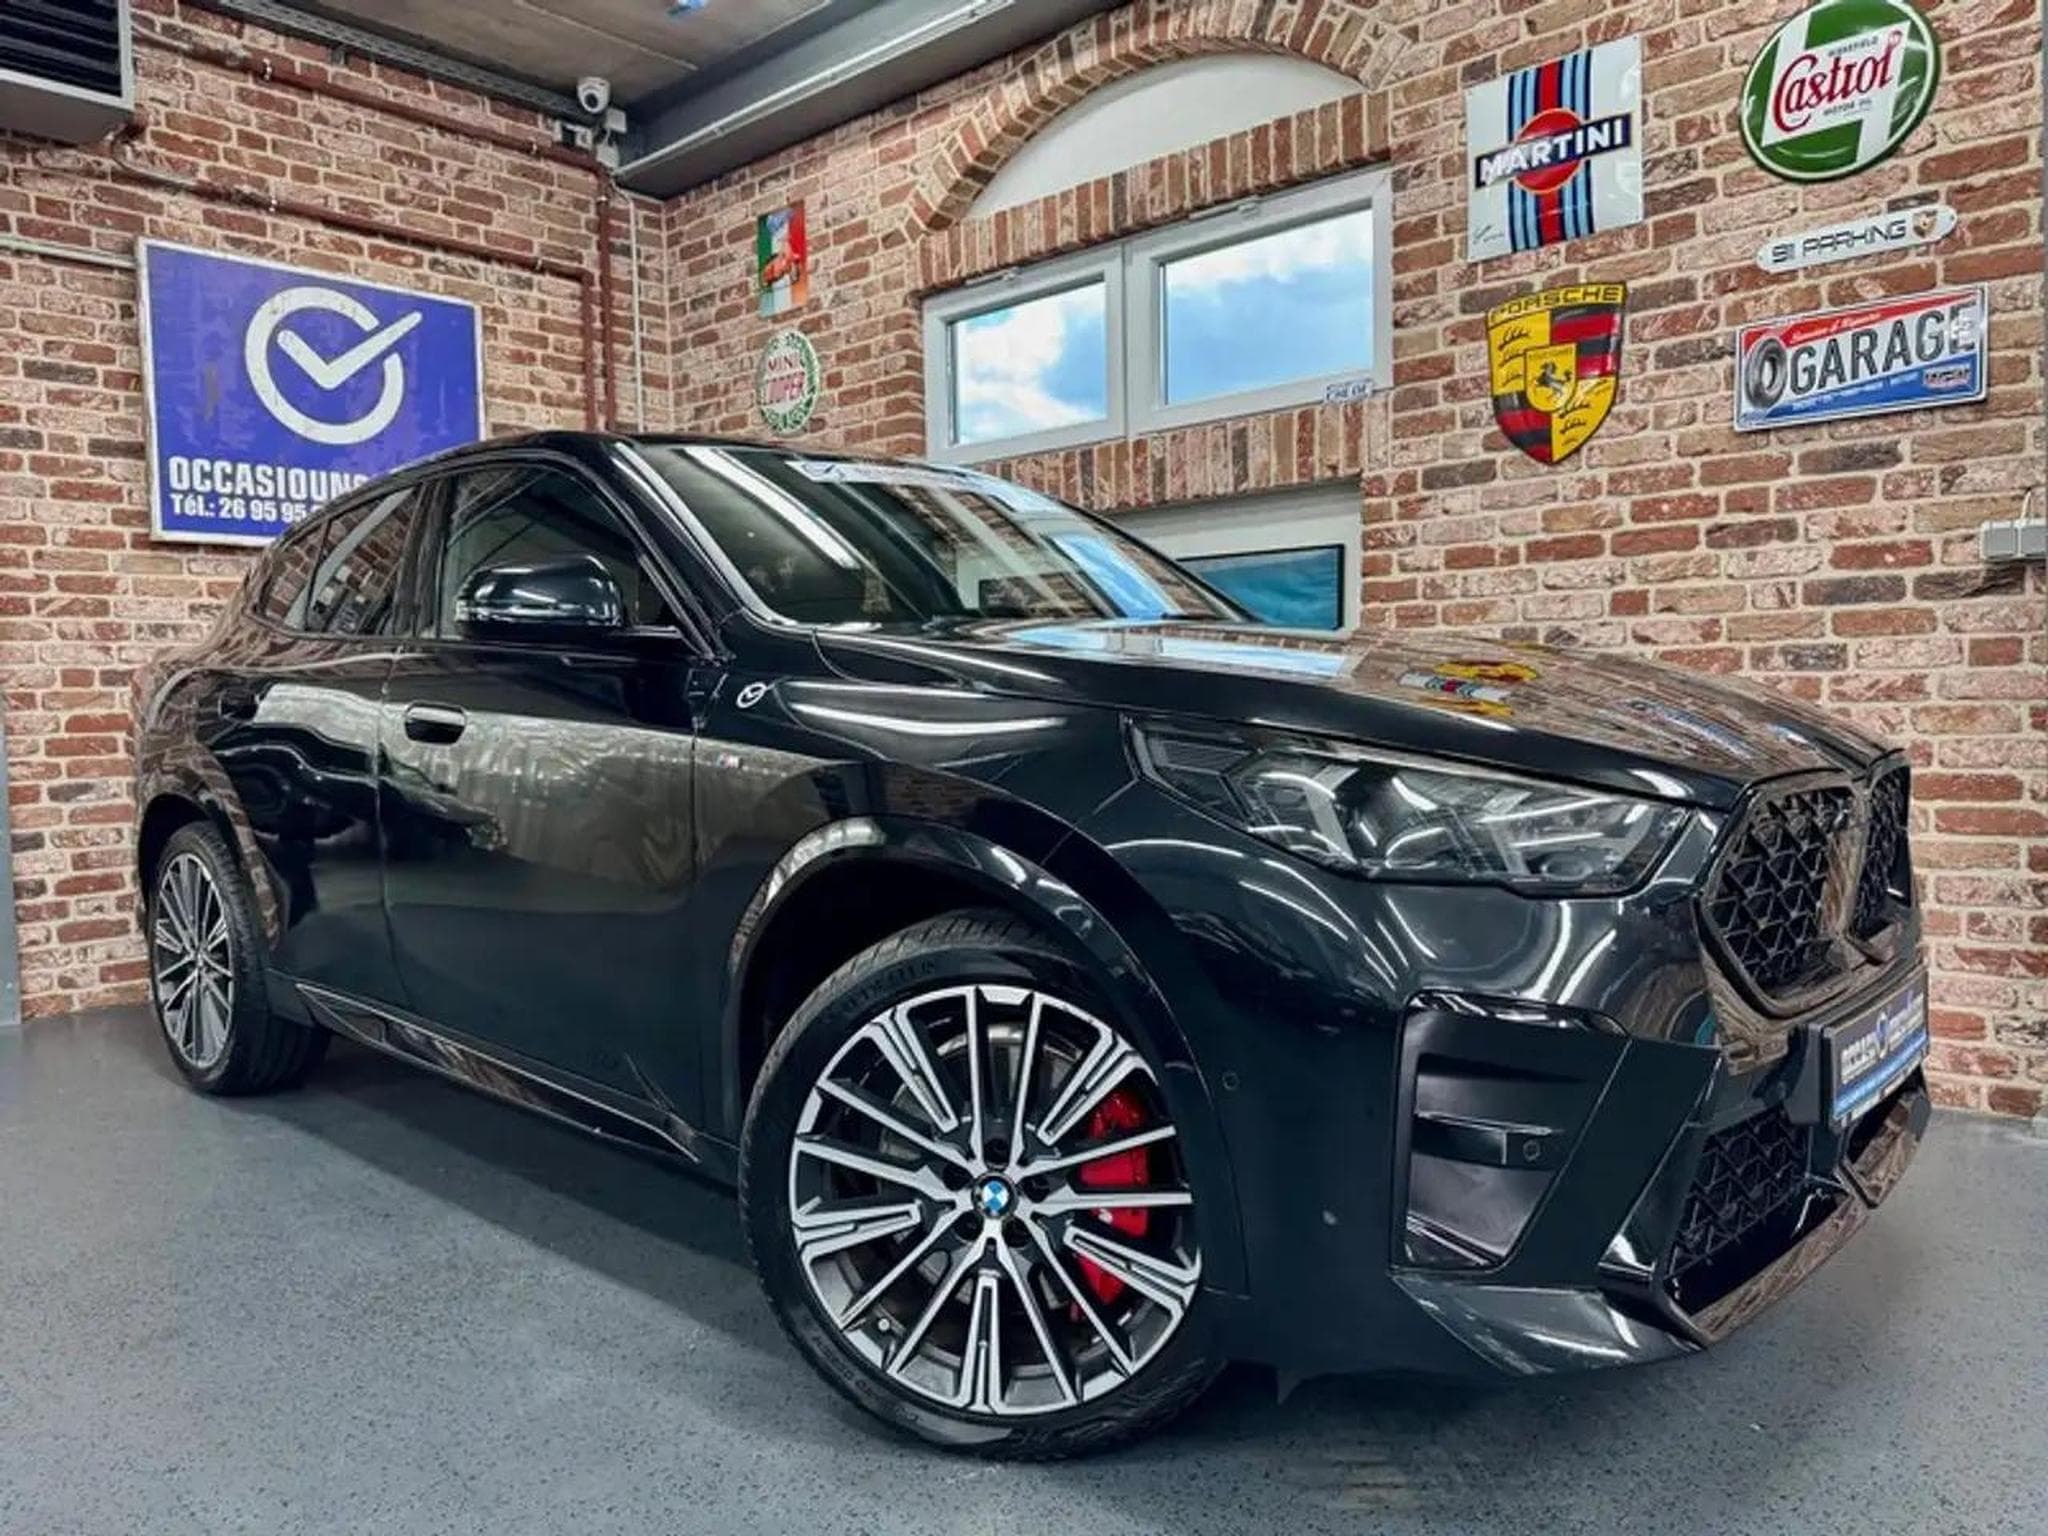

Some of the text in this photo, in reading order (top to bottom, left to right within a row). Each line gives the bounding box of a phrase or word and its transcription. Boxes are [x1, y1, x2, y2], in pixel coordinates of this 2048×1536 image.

[1773, 30, 1902, 132] Castrol
[1480, 119, 1624, 186] MARTINI
[1803, 219, 1907, 257] PARKING
[1489, 286, 1621, 322] PORSCHE
[1790, 302, 1977, 396] GARAGE
[218, 496, 247, 521] 26
[250, 499, 277, 523] 95
[280, 502, 307, 524] 95
